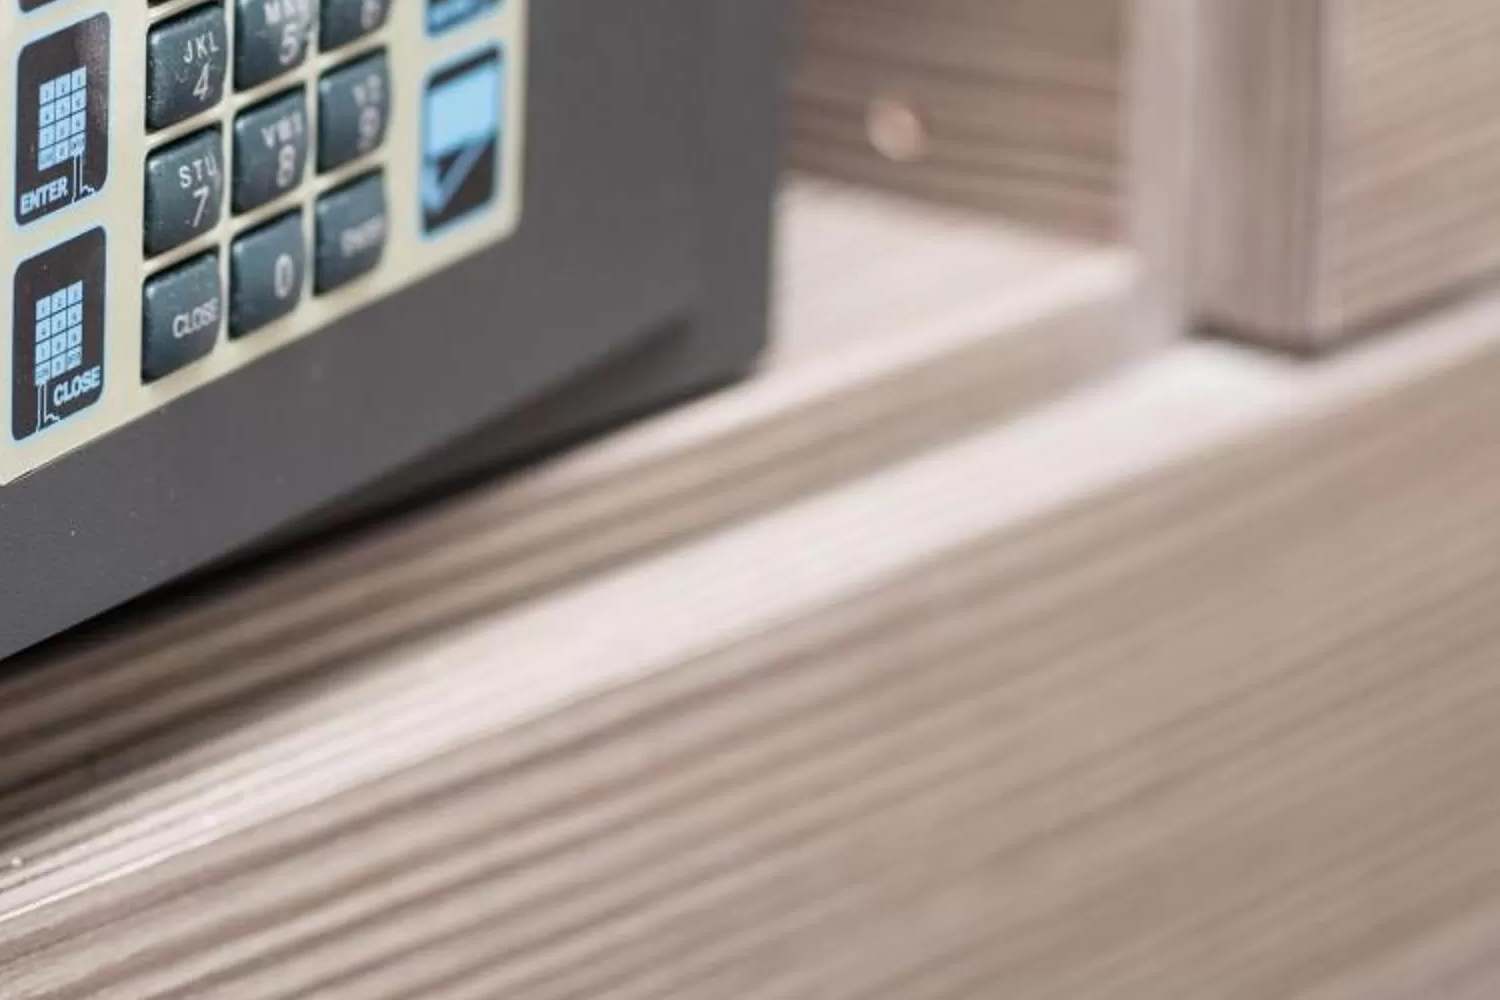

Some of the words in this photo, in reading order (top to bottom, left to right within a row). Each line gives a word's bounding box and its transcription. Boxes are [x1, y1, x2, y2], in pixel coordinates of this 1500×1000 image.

[183, 31, 220, 64] JKL
[279, 23, 299, 66] 5
[192, 62, 211, 101] 4
[179, 152, 218, 189] STU
[275, 144, 297, 189] 8
[19, 174, 69, 216] ENTER
[191, 185, 210, 229] 7
[274, 252, 294, 300] 0
[53, 365, 101, 408] CLOSE
